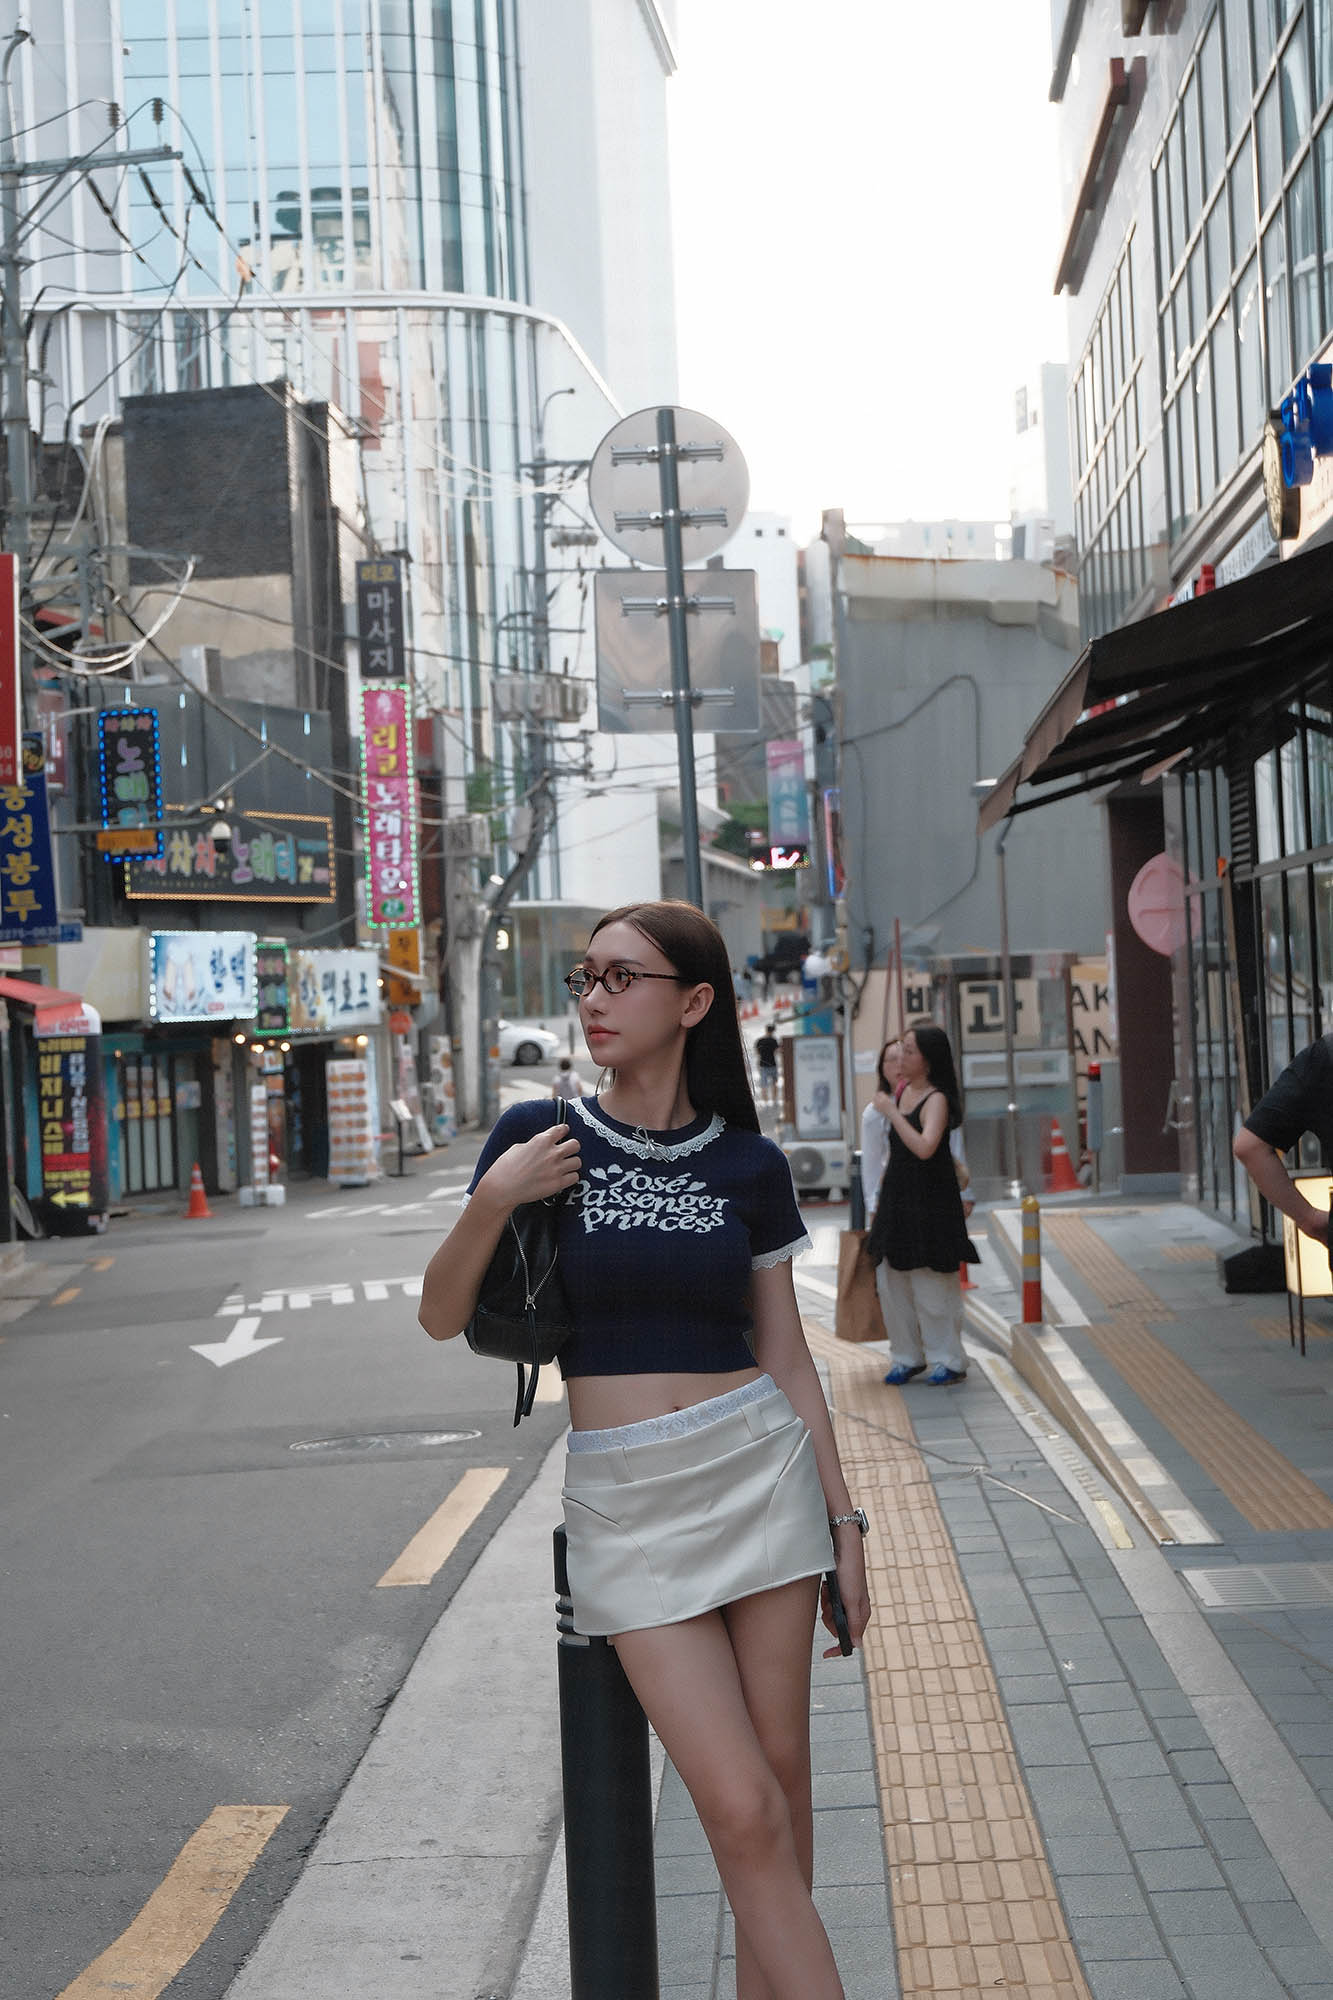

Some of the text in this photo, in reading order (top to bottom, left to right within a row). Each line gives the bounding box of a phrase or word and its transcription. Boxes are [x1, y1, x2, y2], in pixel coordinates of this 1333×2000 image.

[367, 586, 394, 673] 마사지
[375, 782, 402, 894] 노래타운
[579, 1207, 725, 1233] princess
